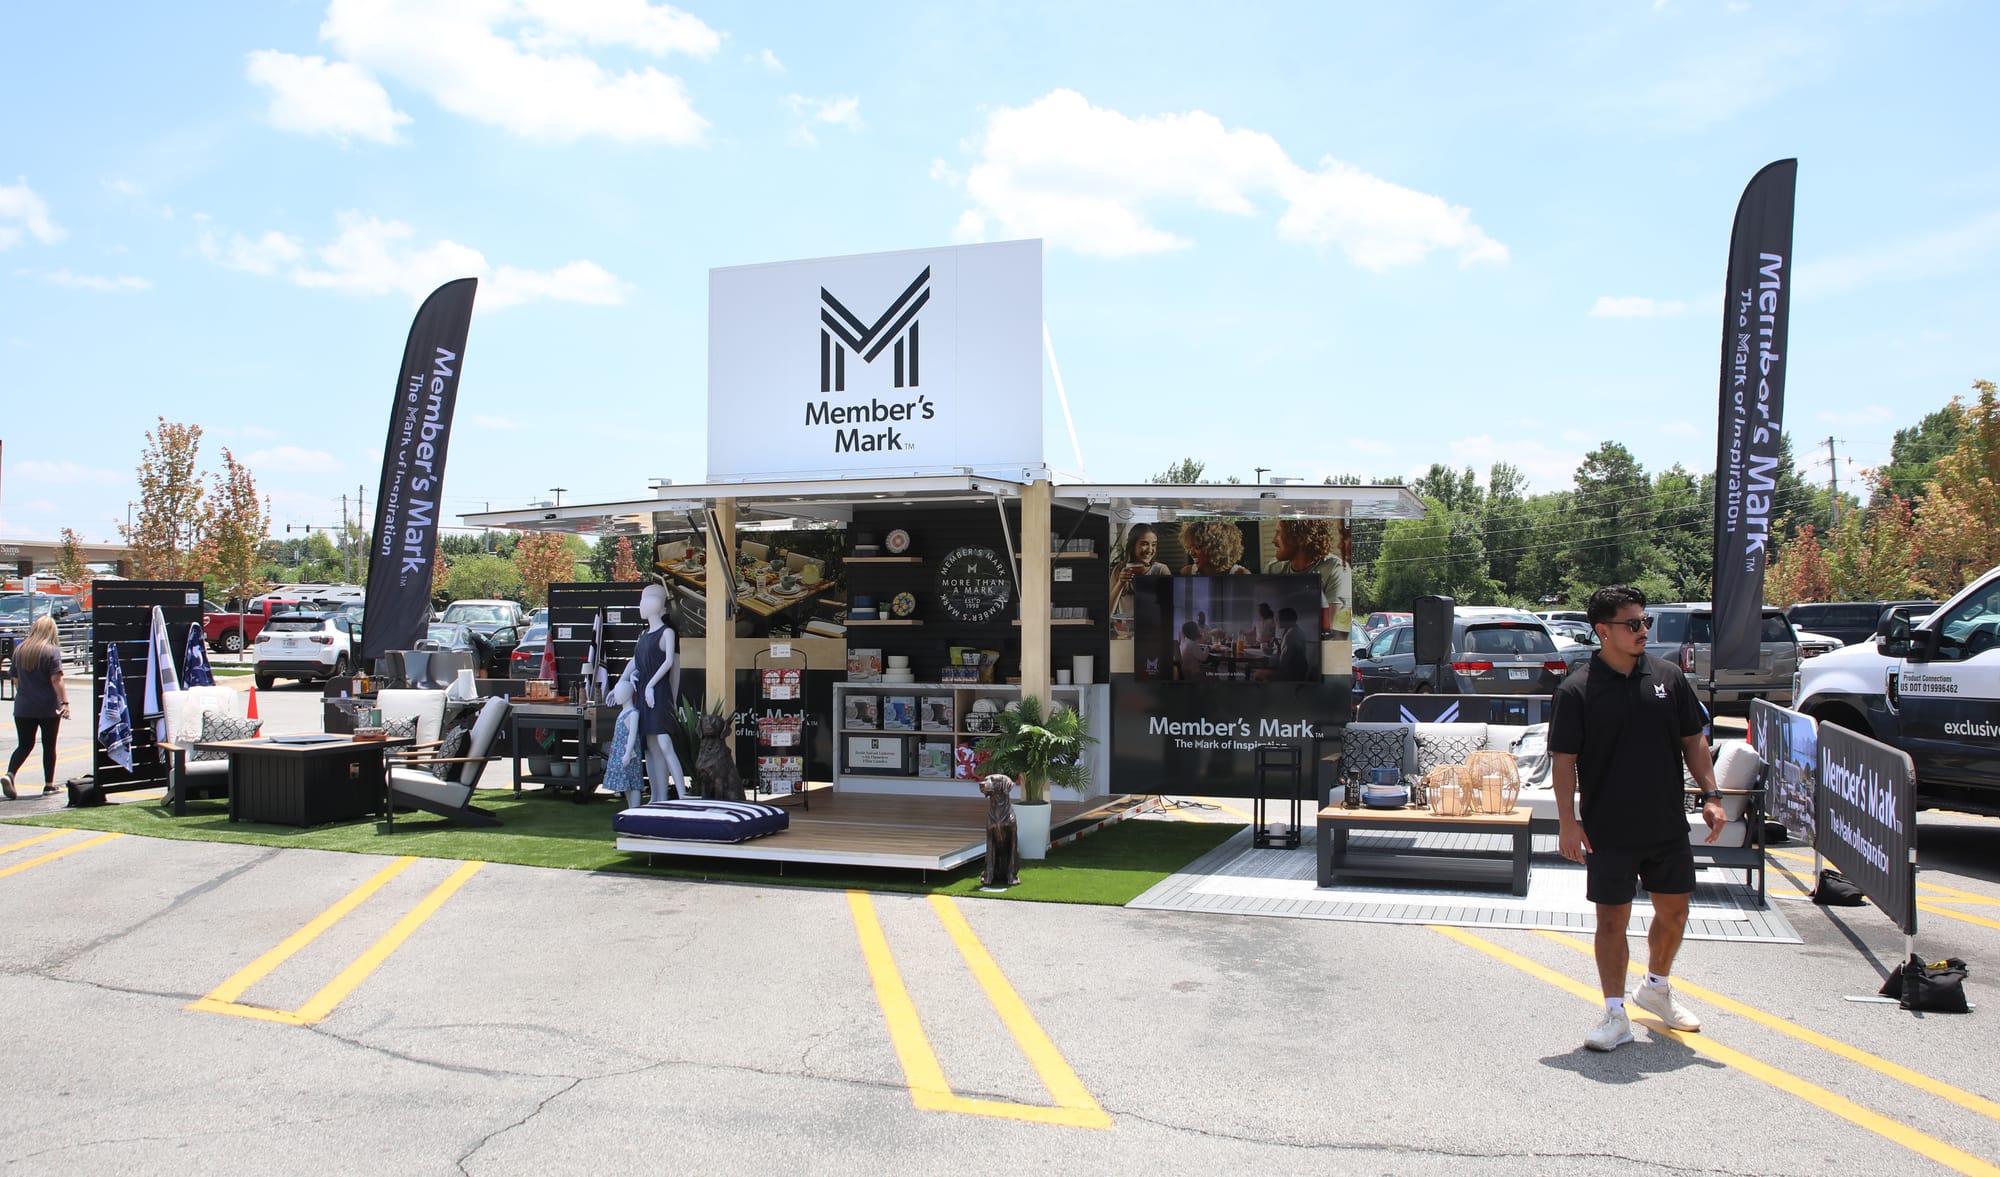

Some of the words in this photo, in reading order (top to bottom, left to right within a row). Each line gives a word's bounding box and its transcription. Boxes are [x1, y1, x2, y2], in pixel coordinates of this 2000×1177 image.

[1738, 287, 1753, 327] The
[1734, 332, 1752, 388] Mark
[1752, 252, 1783, 445] Member's
[408, 373, 425, 403] The
[804, 393, 935, 426] Member's
[1734, 391, 1747, 416] of
[400, 406, 420, 447] Mark
[411, 346, 456, 492] Member's
[834, 426, 904, 453] Mark
[1727, 417, 1746, 533] Inspiration
[381, 470, 406, 556] Inspiration
[1745, 453, 1779, 555] Mark
[401, 498, 434, 574] Mark
[940, 548, 984, 576] MEMBER'S
[985, 552, 1006, 577] MARK
[942, 579, 971, 587] MORE
[976, 579, 1005, 587] THAN
[953, 586, 959, 594] A
[964, 586, 993, 594] MARK
[940, 593, 960, 617] MARK
[1900, 682, 1909, 692] US
[1910, 683, 1921, 692] DOT
[1903, 674, 1921, 682] Product
[1922, 674, 1952, 683] Connections
[1149, 716, 1250, 737] Member's
[1259, 718, 1314, 738] Mark
[1944, 719, 2000, 737] exclusiv
[1174, 738, 1193, 749] The
[1194, 739, 1220, 750] Mark
[1221, 739, 1232, 750] of
[1233, 740, 1288, 752] Inspir
[1822, 746, 1866, 812] Member's
[1868, 768, 1897, 831] Mark
